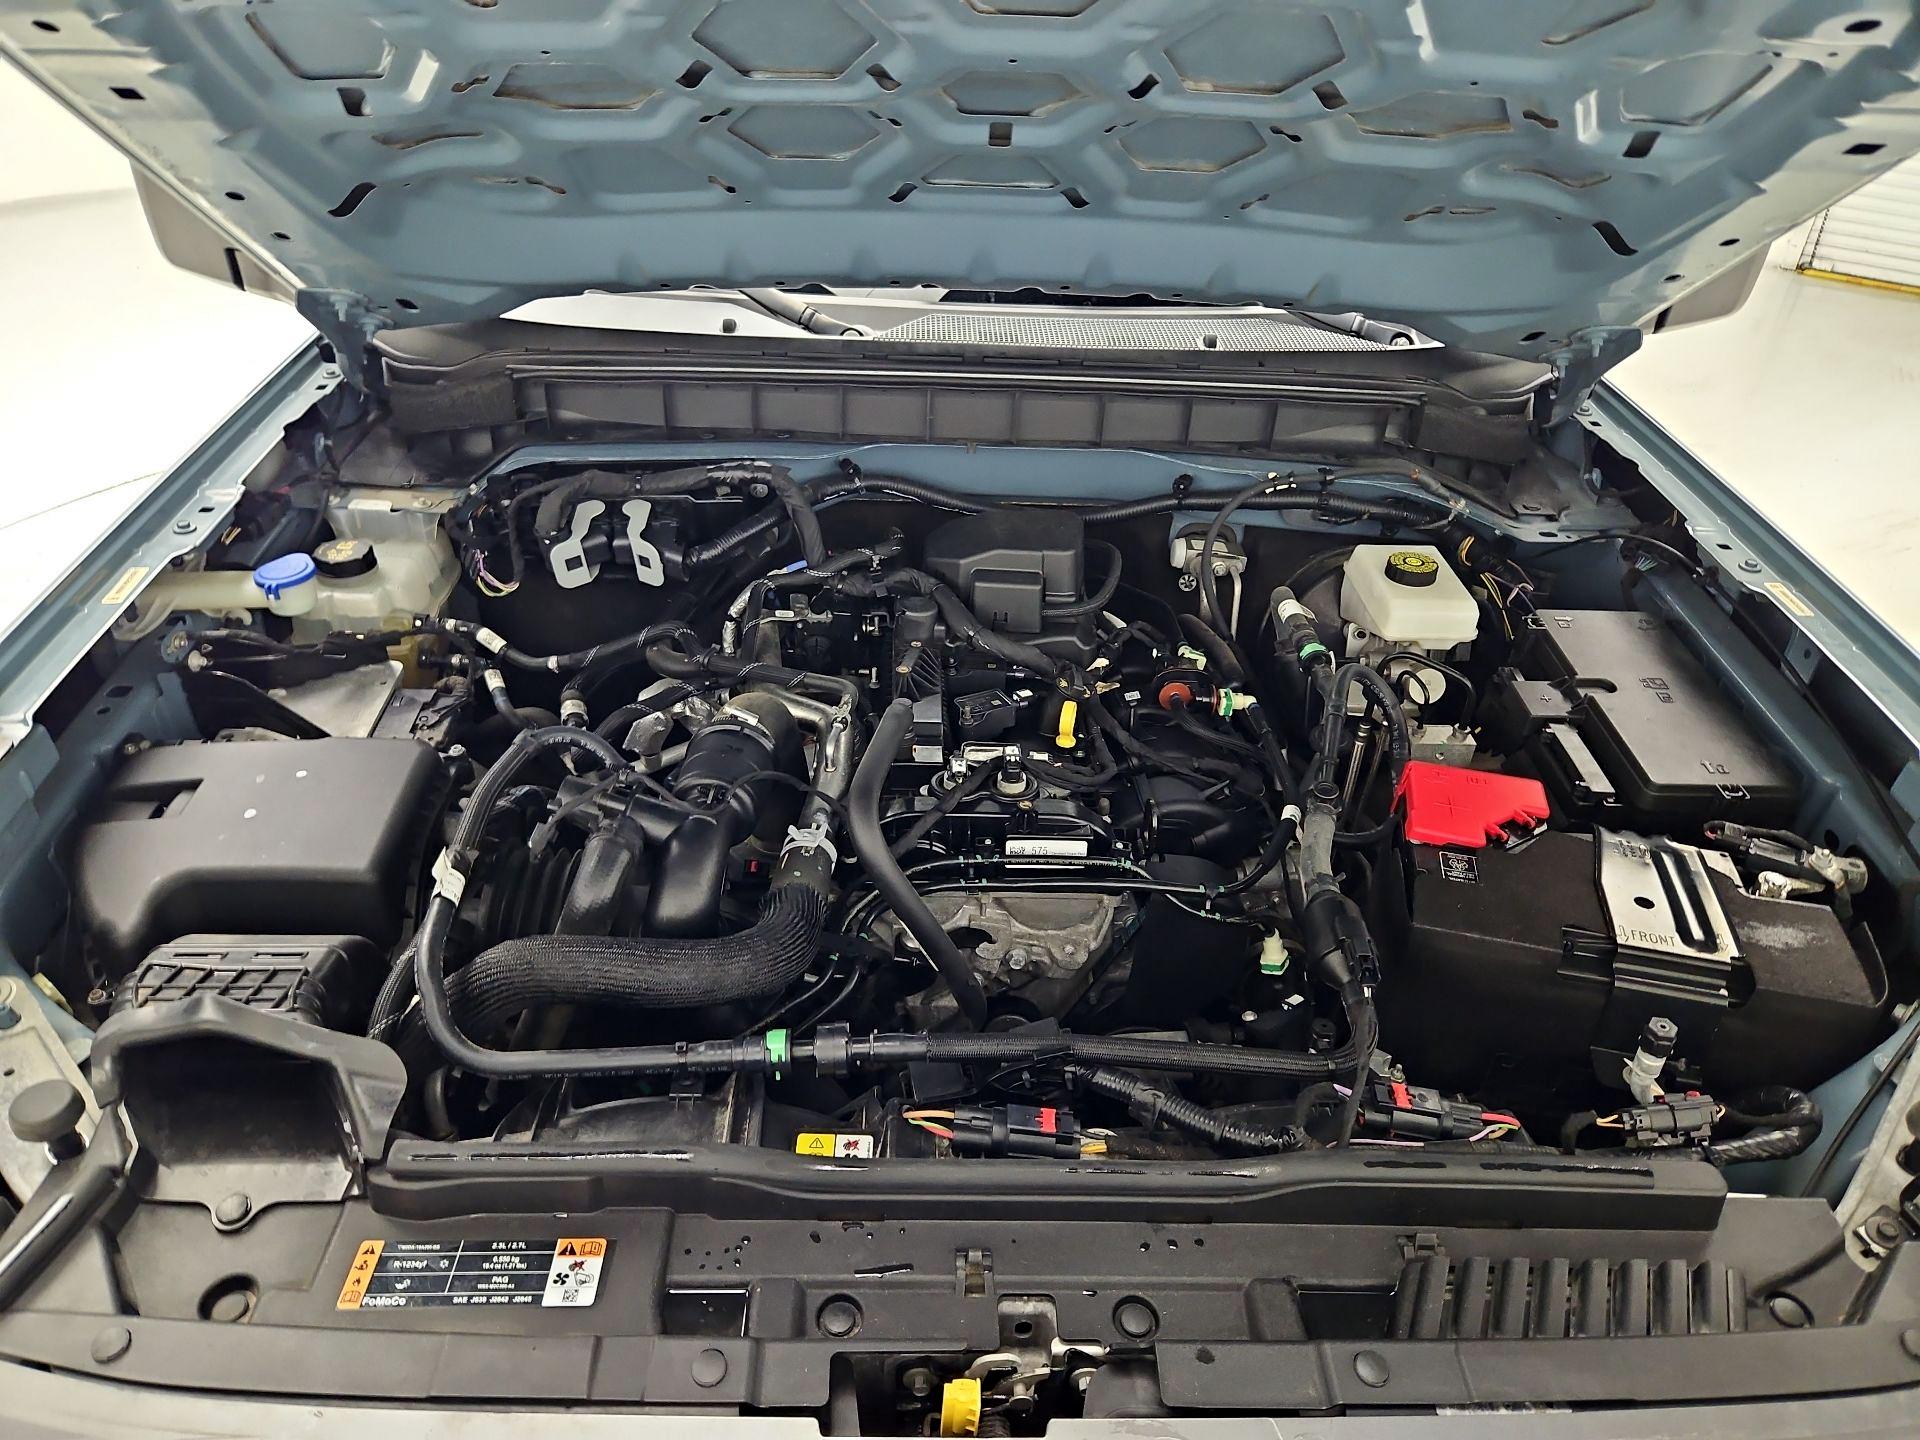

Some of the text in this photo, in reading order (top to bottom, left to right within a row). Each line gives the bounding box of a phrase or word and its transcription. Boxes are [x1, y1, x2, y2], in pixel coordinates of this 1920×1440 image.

[1630, 929, 1676, 948] FRONT
[491, 1275, 509, 1283] PAG
[362, 1296, 407, 1307] FoMoCo
[452, 1296, 468, 1304] SAE
